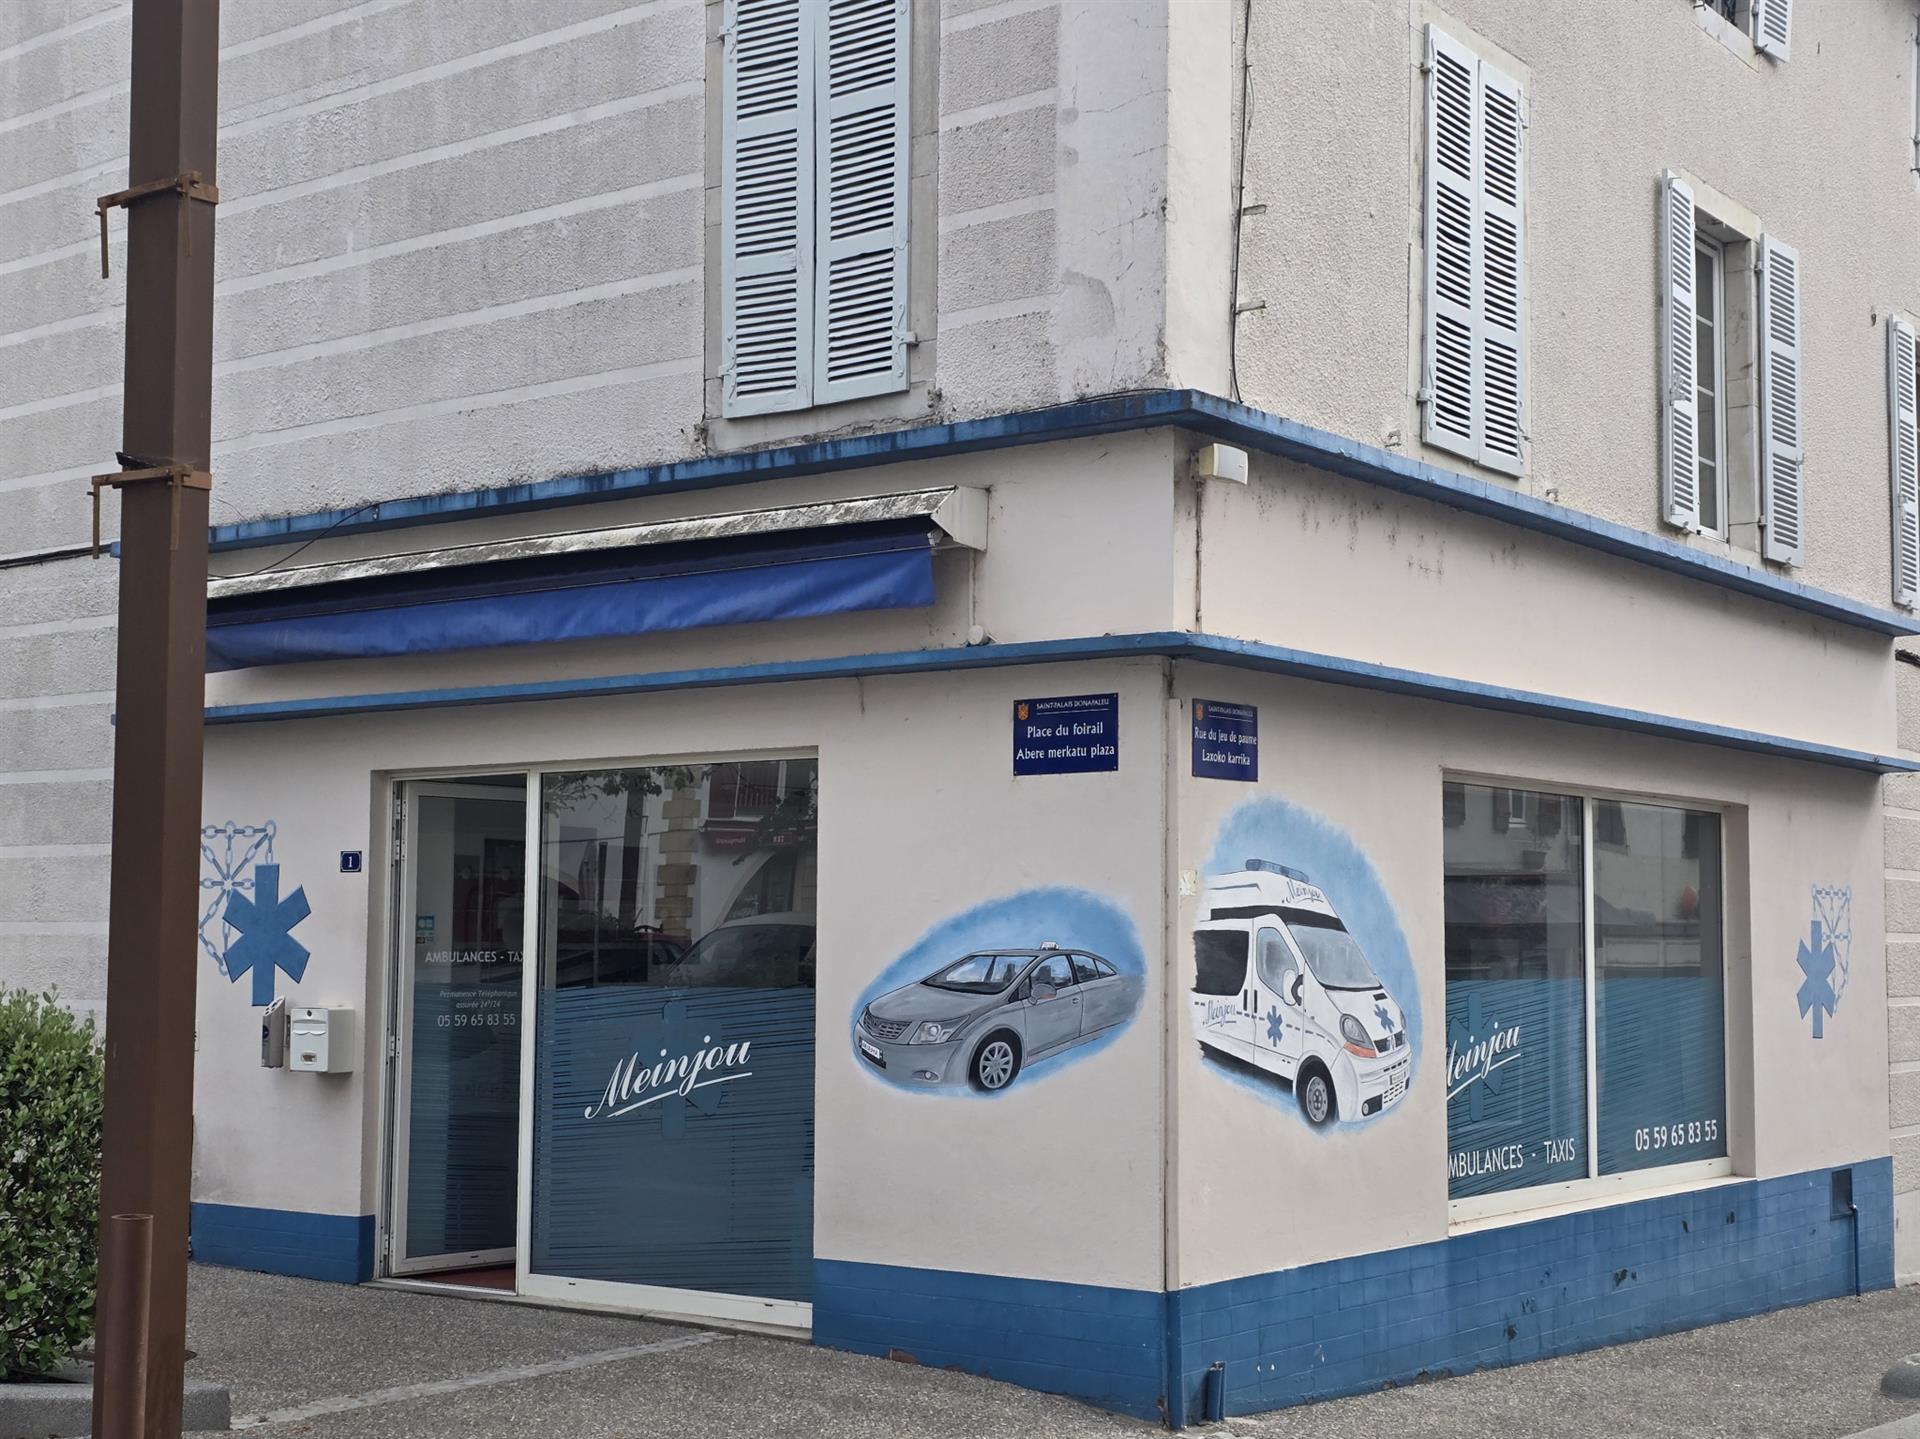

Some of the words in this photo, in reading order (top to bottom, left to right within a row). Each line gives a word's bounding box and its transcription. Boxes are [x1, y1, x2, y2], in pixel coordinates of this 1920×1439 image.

[1027, 725, 1052, 738] Place
[1056, 723, 1069, 736] du
[1073, 721, 1104, 735] foirail
[1194, 726, 1206, 740] Rue
[1208, 727, 1217, 740] du
[1218, 729, 1228, 744] jeu
[1229, 730, 1237, 743] de
[1238, 735, 1257, 747] paume
[1016, 749, 1045, 760] Abere
[1048, 746, 1087, 758] merkatu
[1091, 743, 1115, 758] plaza
[1202, 749, 1226, 763] Laxoko
[1228, 752, 1251, 766] karrika
[348, 856, 353, 868] 1
[425, 951, 497, 963] AMBULANCES
[437, 1014, 451, 1027] 05
[454, 1014, 467, 1027] 59
[470, 1014, 484, 1026] 65
[487, 1013, 500, 1026] 83
[503, 1013, 516, 1025] 55
[584, 1035, 751, 1119] Meinjou
[1635, 1128, 1650, 1151] 05
[1653, 1126, 1667, 1148] 59
[1671, 1124, 1685, 1146] 65
[1688, 1122, 1702, 1144] 83
[1705, 1119, 1718, 1141] 55
[1448, 1145, 1523, 1178] MBULANCES
[1543, 1137, 1576, 1164] TAXIS
